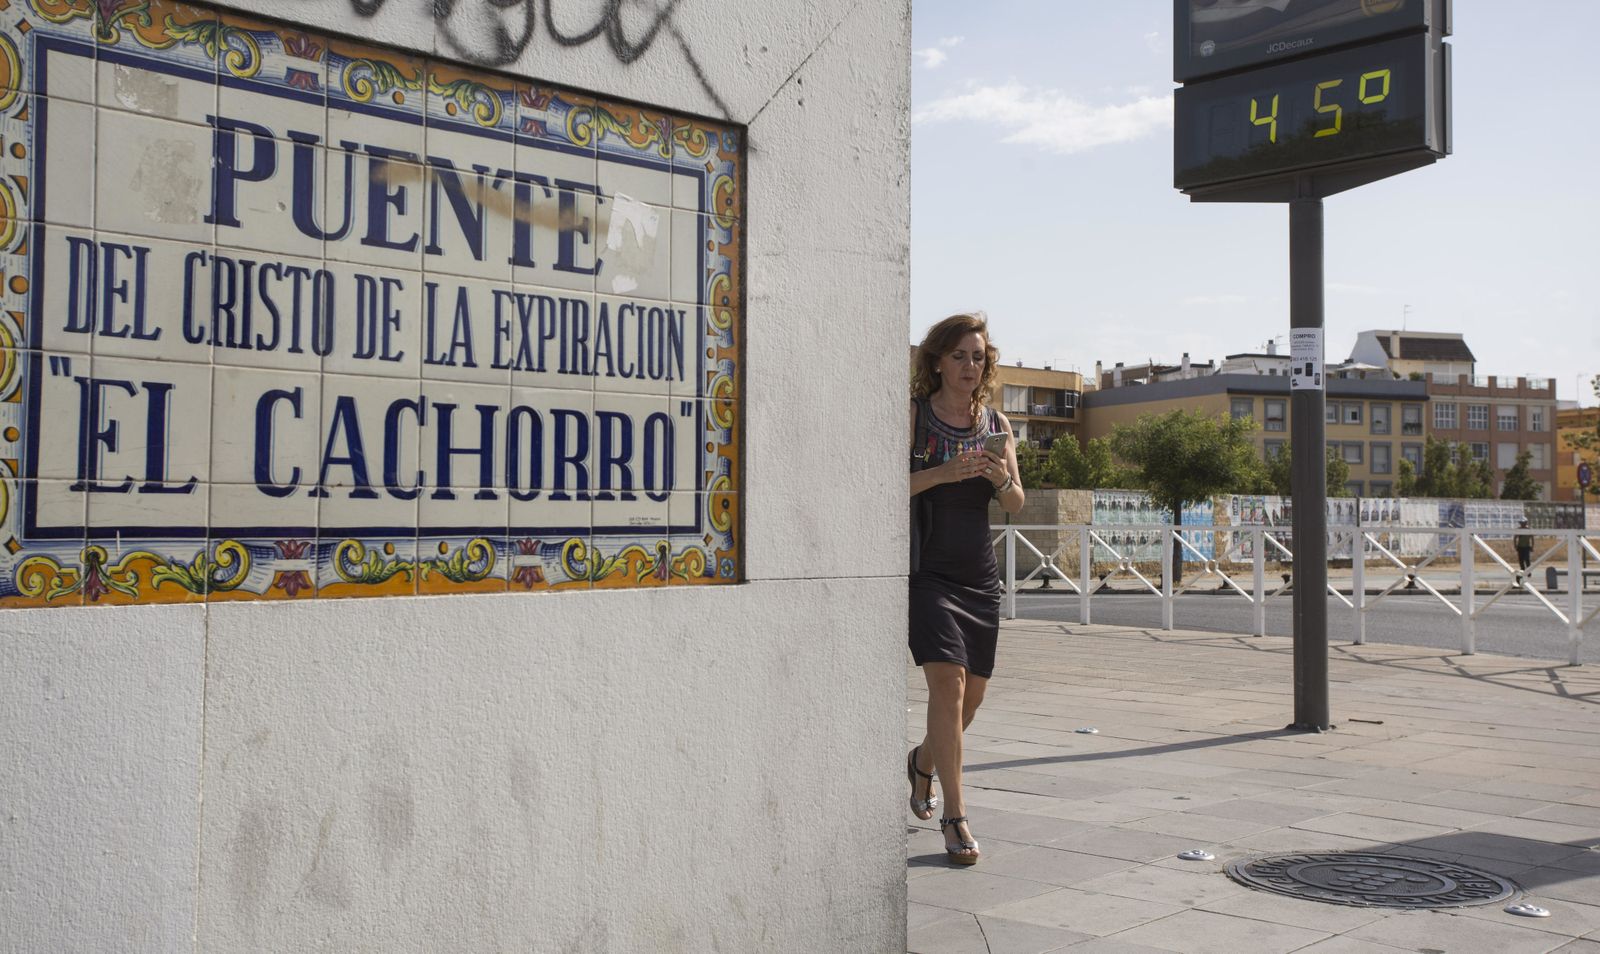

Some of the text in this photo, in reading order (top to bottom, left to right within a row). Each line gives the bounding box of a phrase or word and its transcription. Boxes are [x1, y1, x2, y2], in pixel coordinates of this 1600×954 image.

[1266, 37, 1315, 54] JCDecaux
[203, 114, 609, 277] PUENTE
[63, 236, 687, 382] DEL CRISTO DE LA EXPIRACION
[50, 356, 693, 502] "EL CACHORRO"
